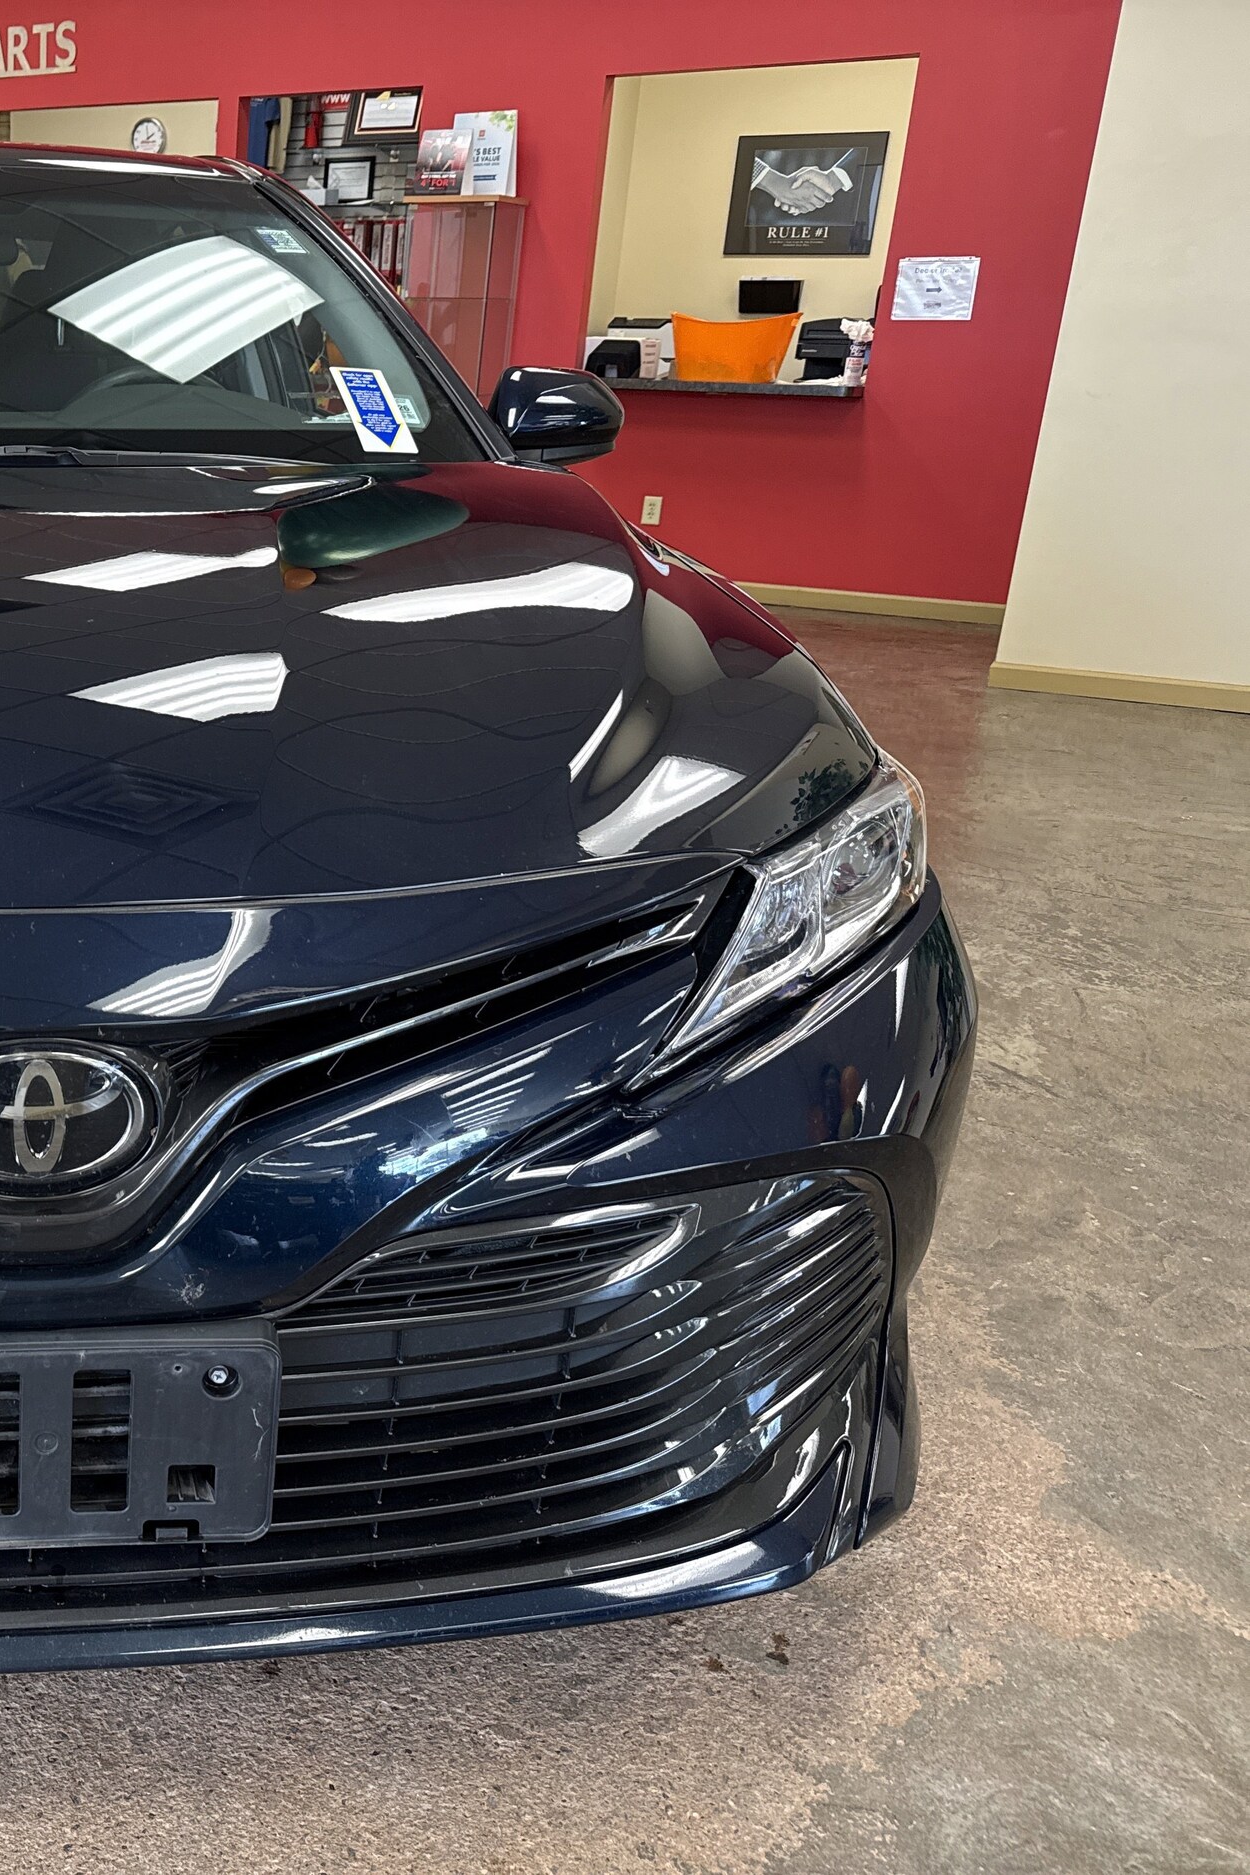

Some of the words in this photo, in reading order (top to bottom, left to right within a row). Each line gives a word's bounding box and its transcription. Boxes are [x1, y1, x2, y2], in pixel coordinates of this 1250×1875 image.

[482, 147, 502, 156] BEST
[481, 155, 500, 163] VALUE
[767, 226, 811, 239] RULE
[814, 226, 829, 239] #1
